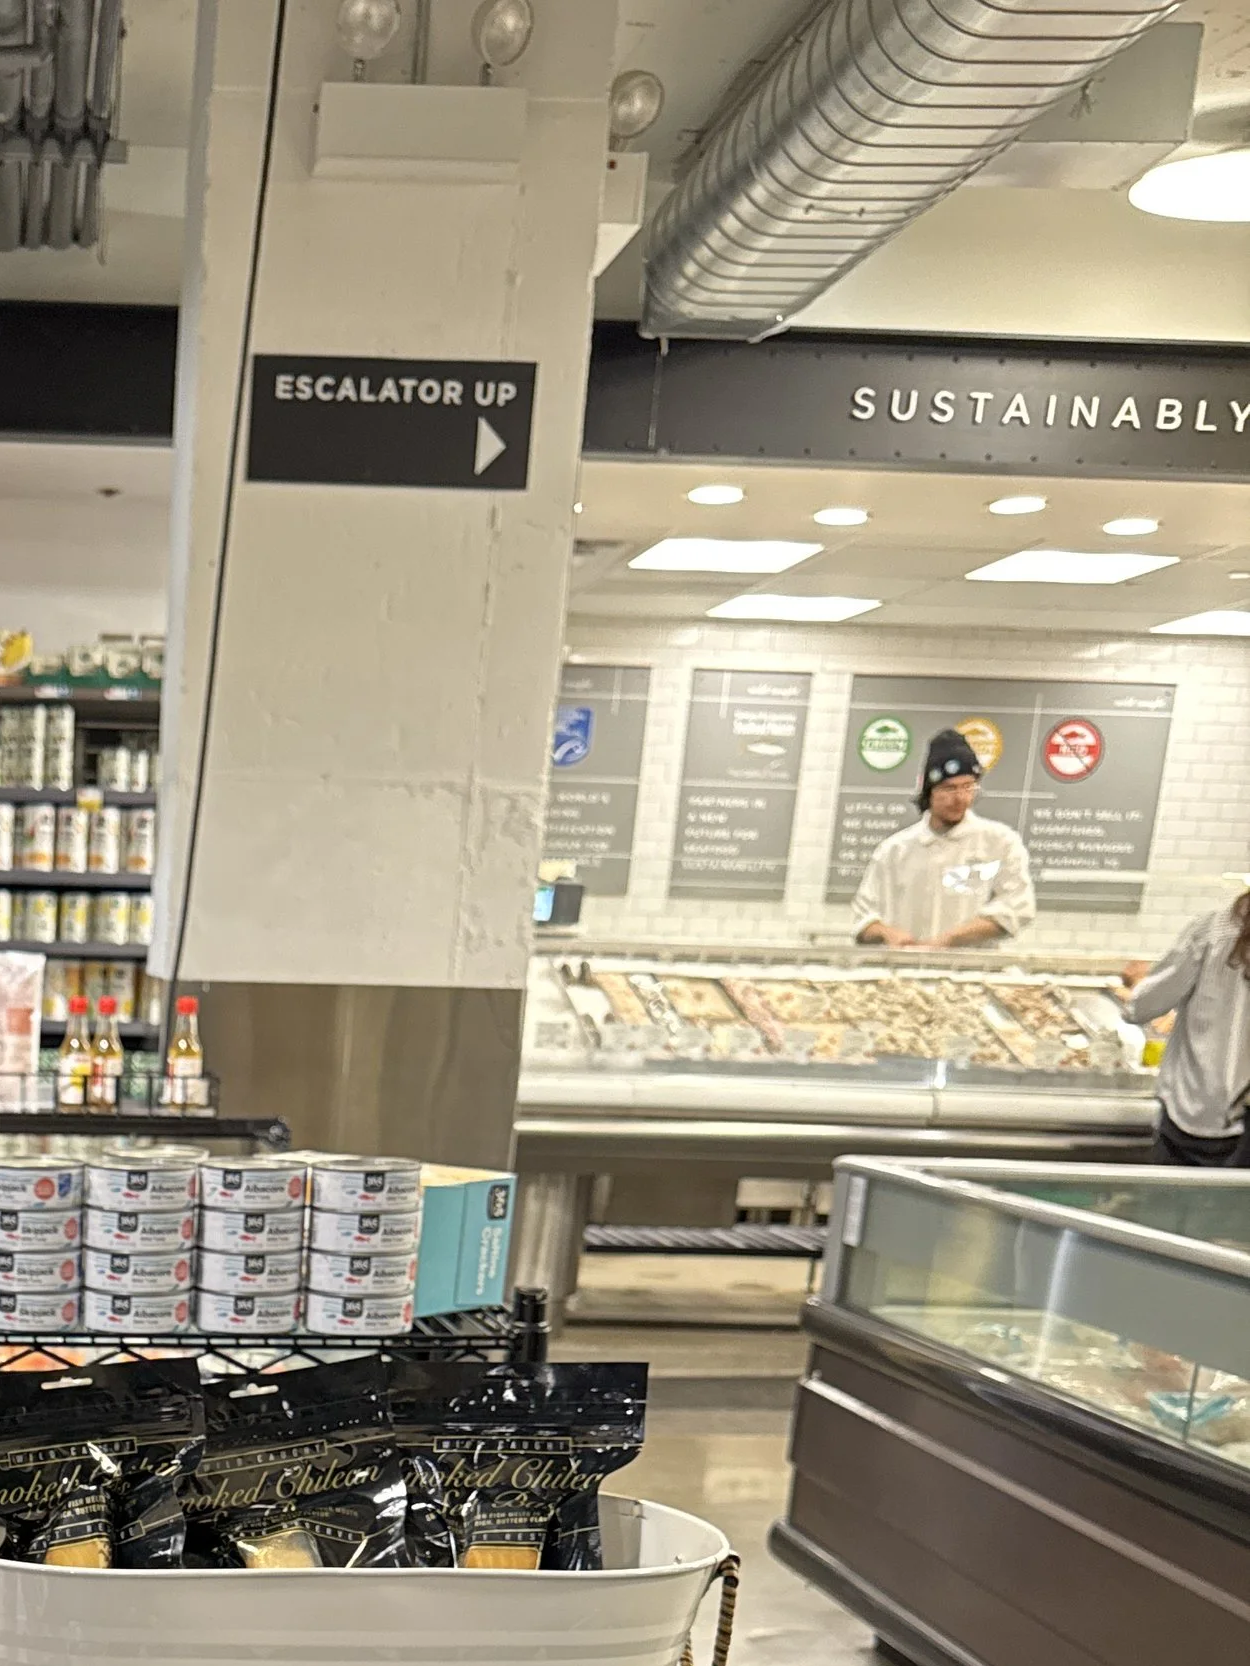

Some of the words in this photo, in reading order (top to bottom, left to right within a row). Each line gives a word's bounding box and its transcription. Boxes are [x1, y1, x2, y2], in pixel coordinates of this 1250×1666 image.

[274, 373, 463, 406] ESCALATOR
[474, 380, 518, 407] UP
[851, 386, 1250, 434] SUSTAINABLY
[275, 1459, 381, 1499] Chilean
